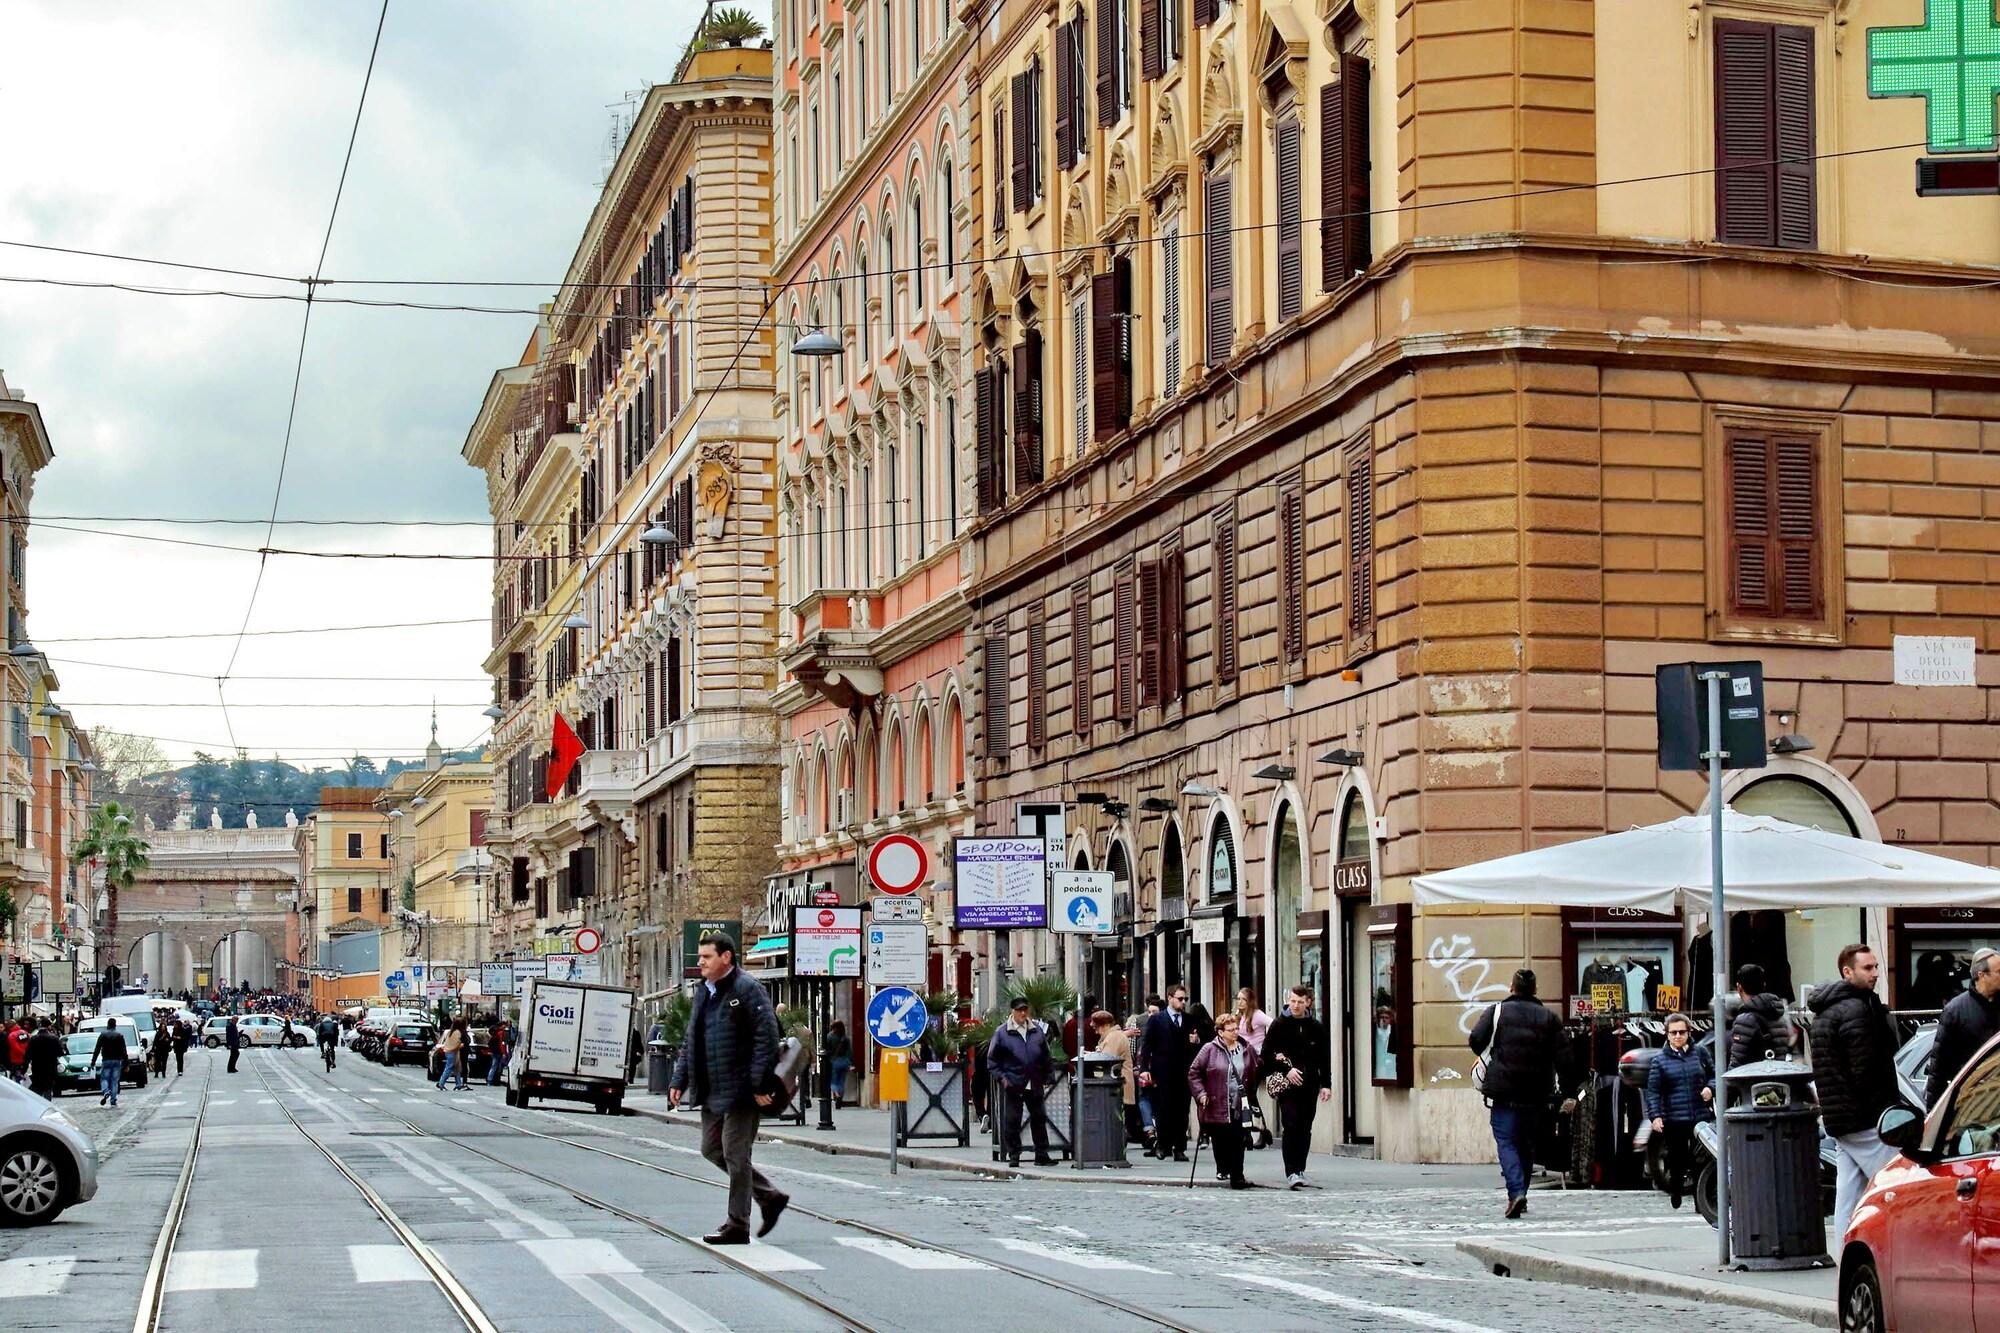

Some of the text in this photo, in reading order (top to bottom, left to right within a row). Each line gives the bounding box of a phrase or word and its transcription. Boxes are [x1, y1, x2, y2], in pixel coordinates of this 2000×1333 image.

[706, 472, 728, 511] 1885
[1923, 640, 1945, 653] VIA
[1919, 656, 1952, 666] DEGLI
[1904, 669, 1966, 681] SCIPIONI
[1051, 844, 1064, 852] 274
[1337, 866, 1367, 889] CLASS
[1064, 885, 1103, 894] pedonale
[1607, 907, 1644, 916] CLASS
[1940, 909, 1974, 918] CLASS
[1608, 991, 1614, 999] 8
[539, 1004, 574, 1019] Cioli
[547, 1017, 574, 1026] Latticini
